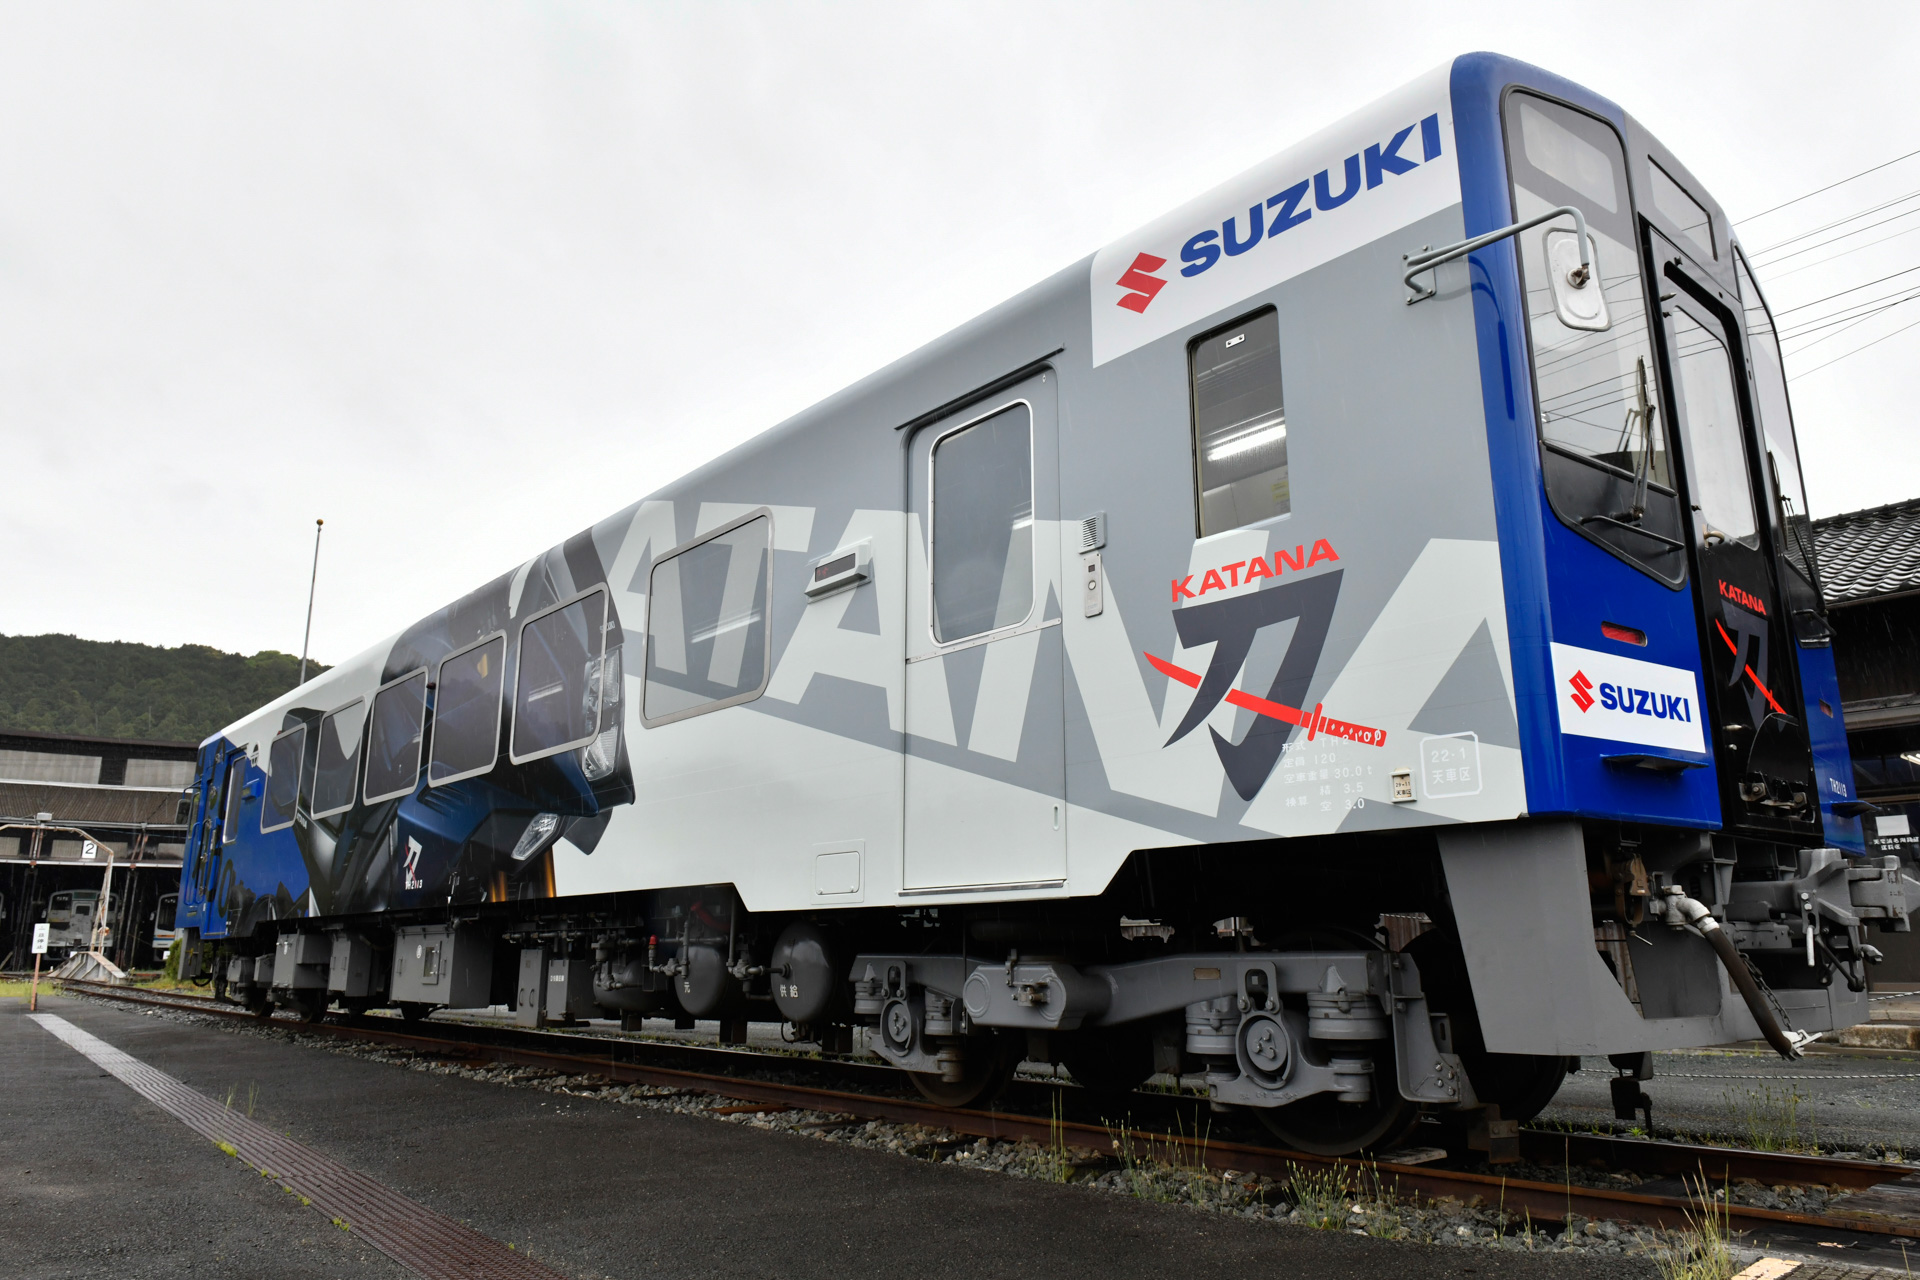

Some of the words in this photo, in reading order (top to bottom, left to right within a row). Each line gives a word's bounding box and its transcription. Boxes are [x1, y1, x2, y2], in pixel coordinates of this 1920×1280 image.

[1180, 112, 1442, 278] SUZUKI
[1171, 538, 1341, 603] KATANA
[1718, 579, 1767, 616] KATANA
[1599, 682, 1692, 723] SUZUKI
[1320, 729, 1382, 748] TH2100
[1314, 753, 1336, 765] 120
[1334, 765, 1362, 779] 30.0
[1432, 766, 1471, 785] 天車区
[1344, 782, 1364, 794] 3.5
[1345, 798, 1365, 810] 3.0
[85, 843, 95, 855] 2
[780, 984, 799, 997] 供給
